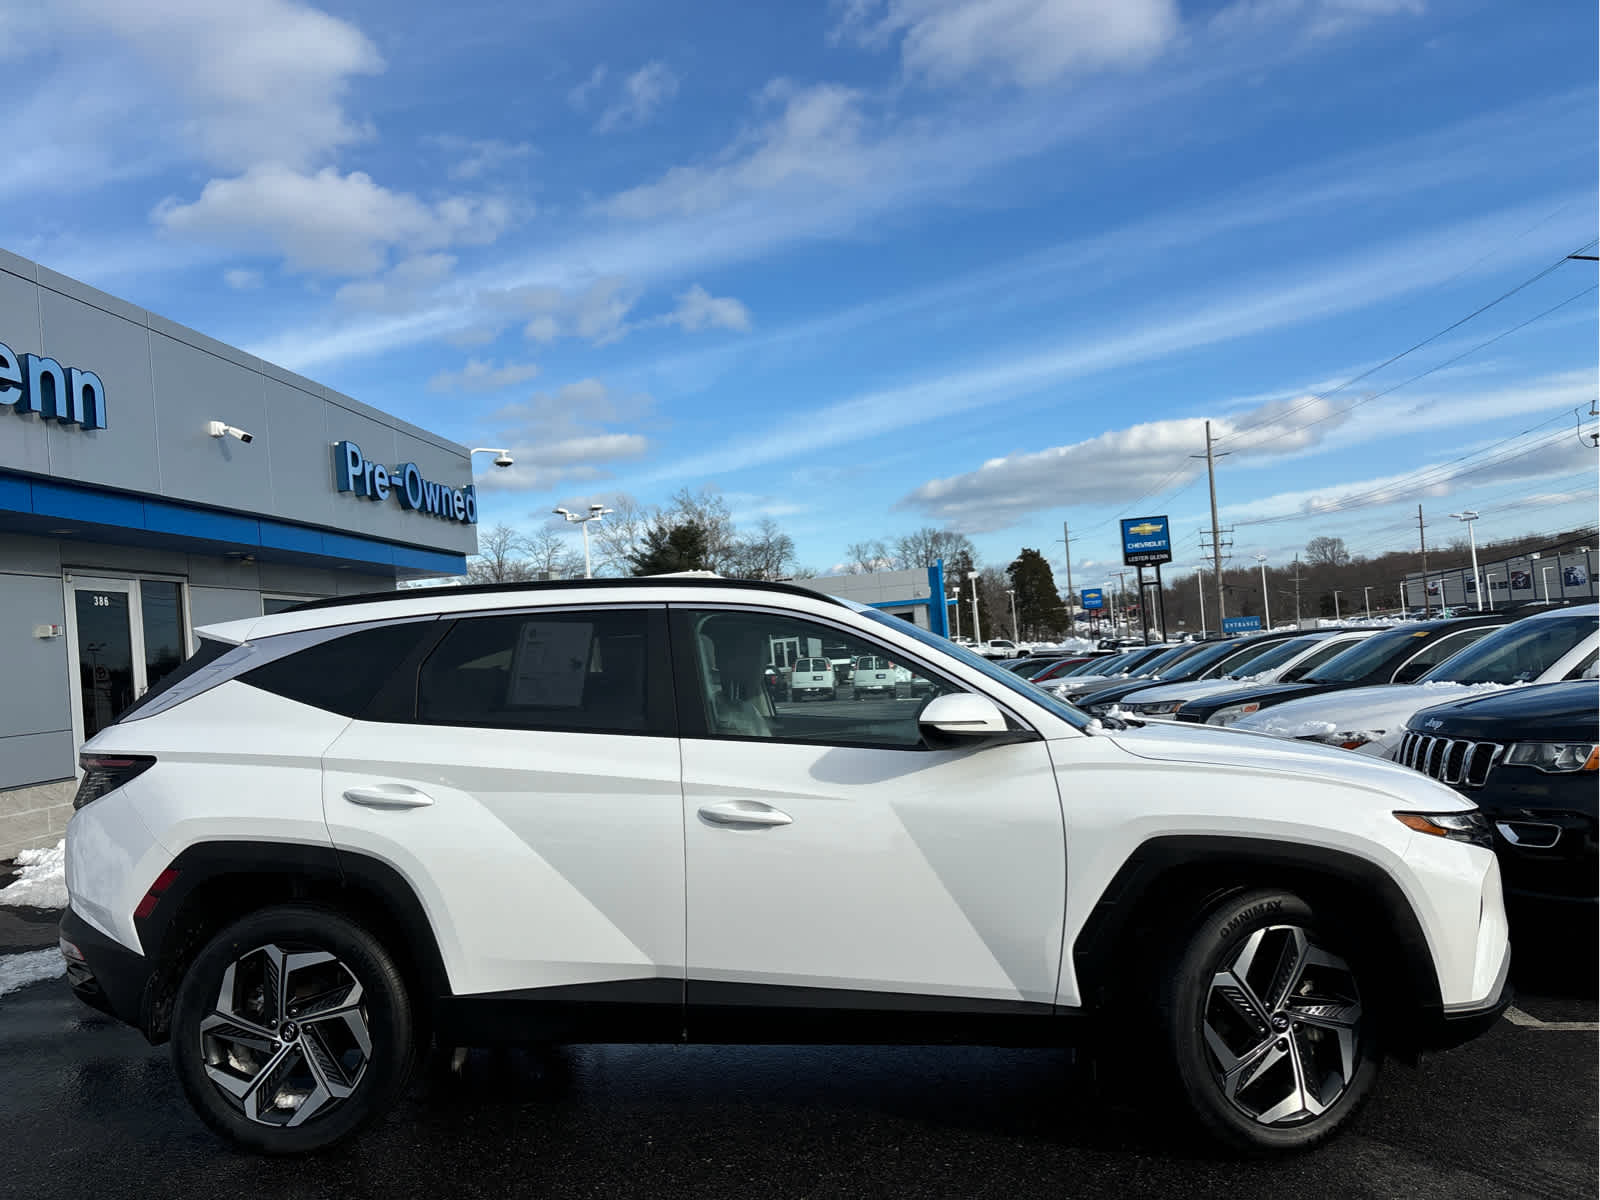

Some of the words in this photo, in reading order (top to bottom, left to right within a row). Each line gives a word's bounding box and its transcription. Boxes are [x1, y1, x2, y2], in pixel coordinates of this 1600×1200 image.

[335, 440, 478, 524] Pre-Owned
[1127, 540, 1166, 549] CHEVROLET
[93, 595, 109, 606] 386
[1220, 900, 1282, 937] OMNIMAX
